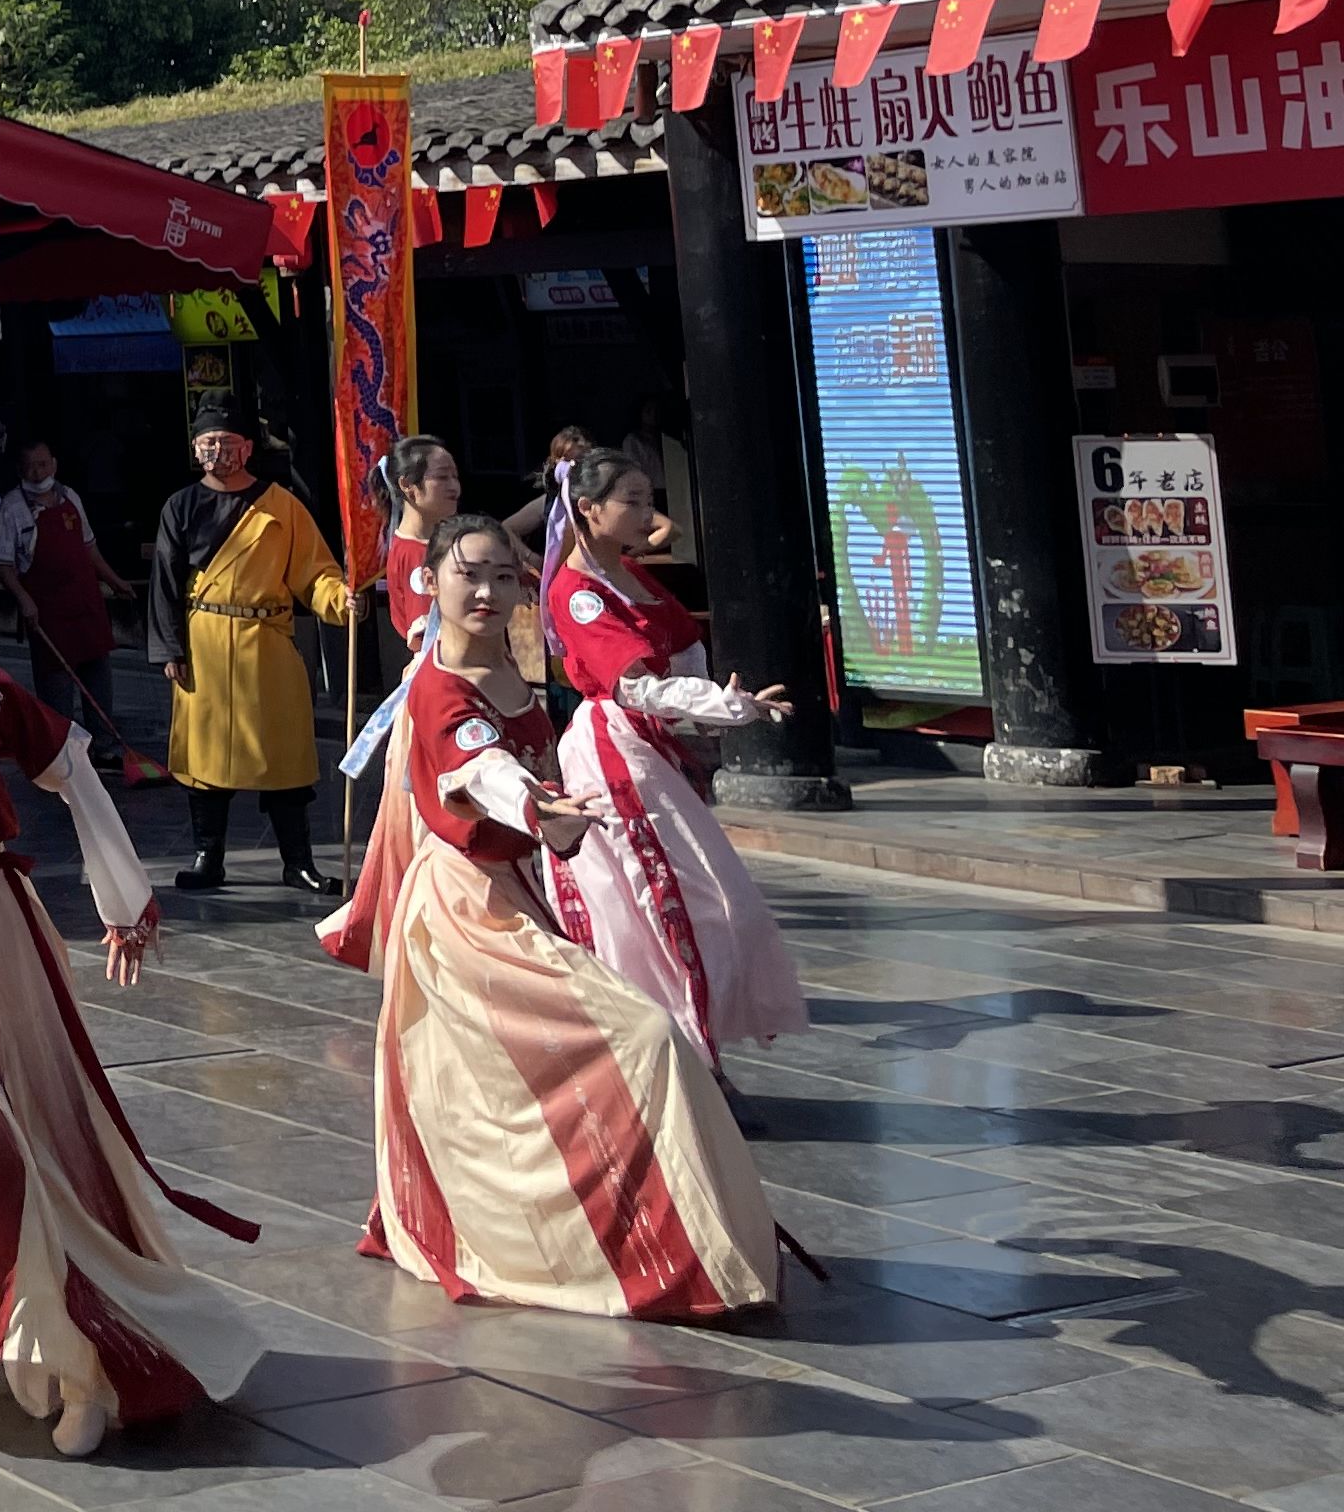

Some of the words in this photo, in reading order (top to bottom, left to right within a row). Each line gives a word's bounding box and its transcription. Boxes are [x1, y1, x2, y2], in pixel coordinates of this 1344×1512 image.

[964, 169, 1068, 195] 男人的加油站
[1092, 445, 1205, 493] 6年老店
